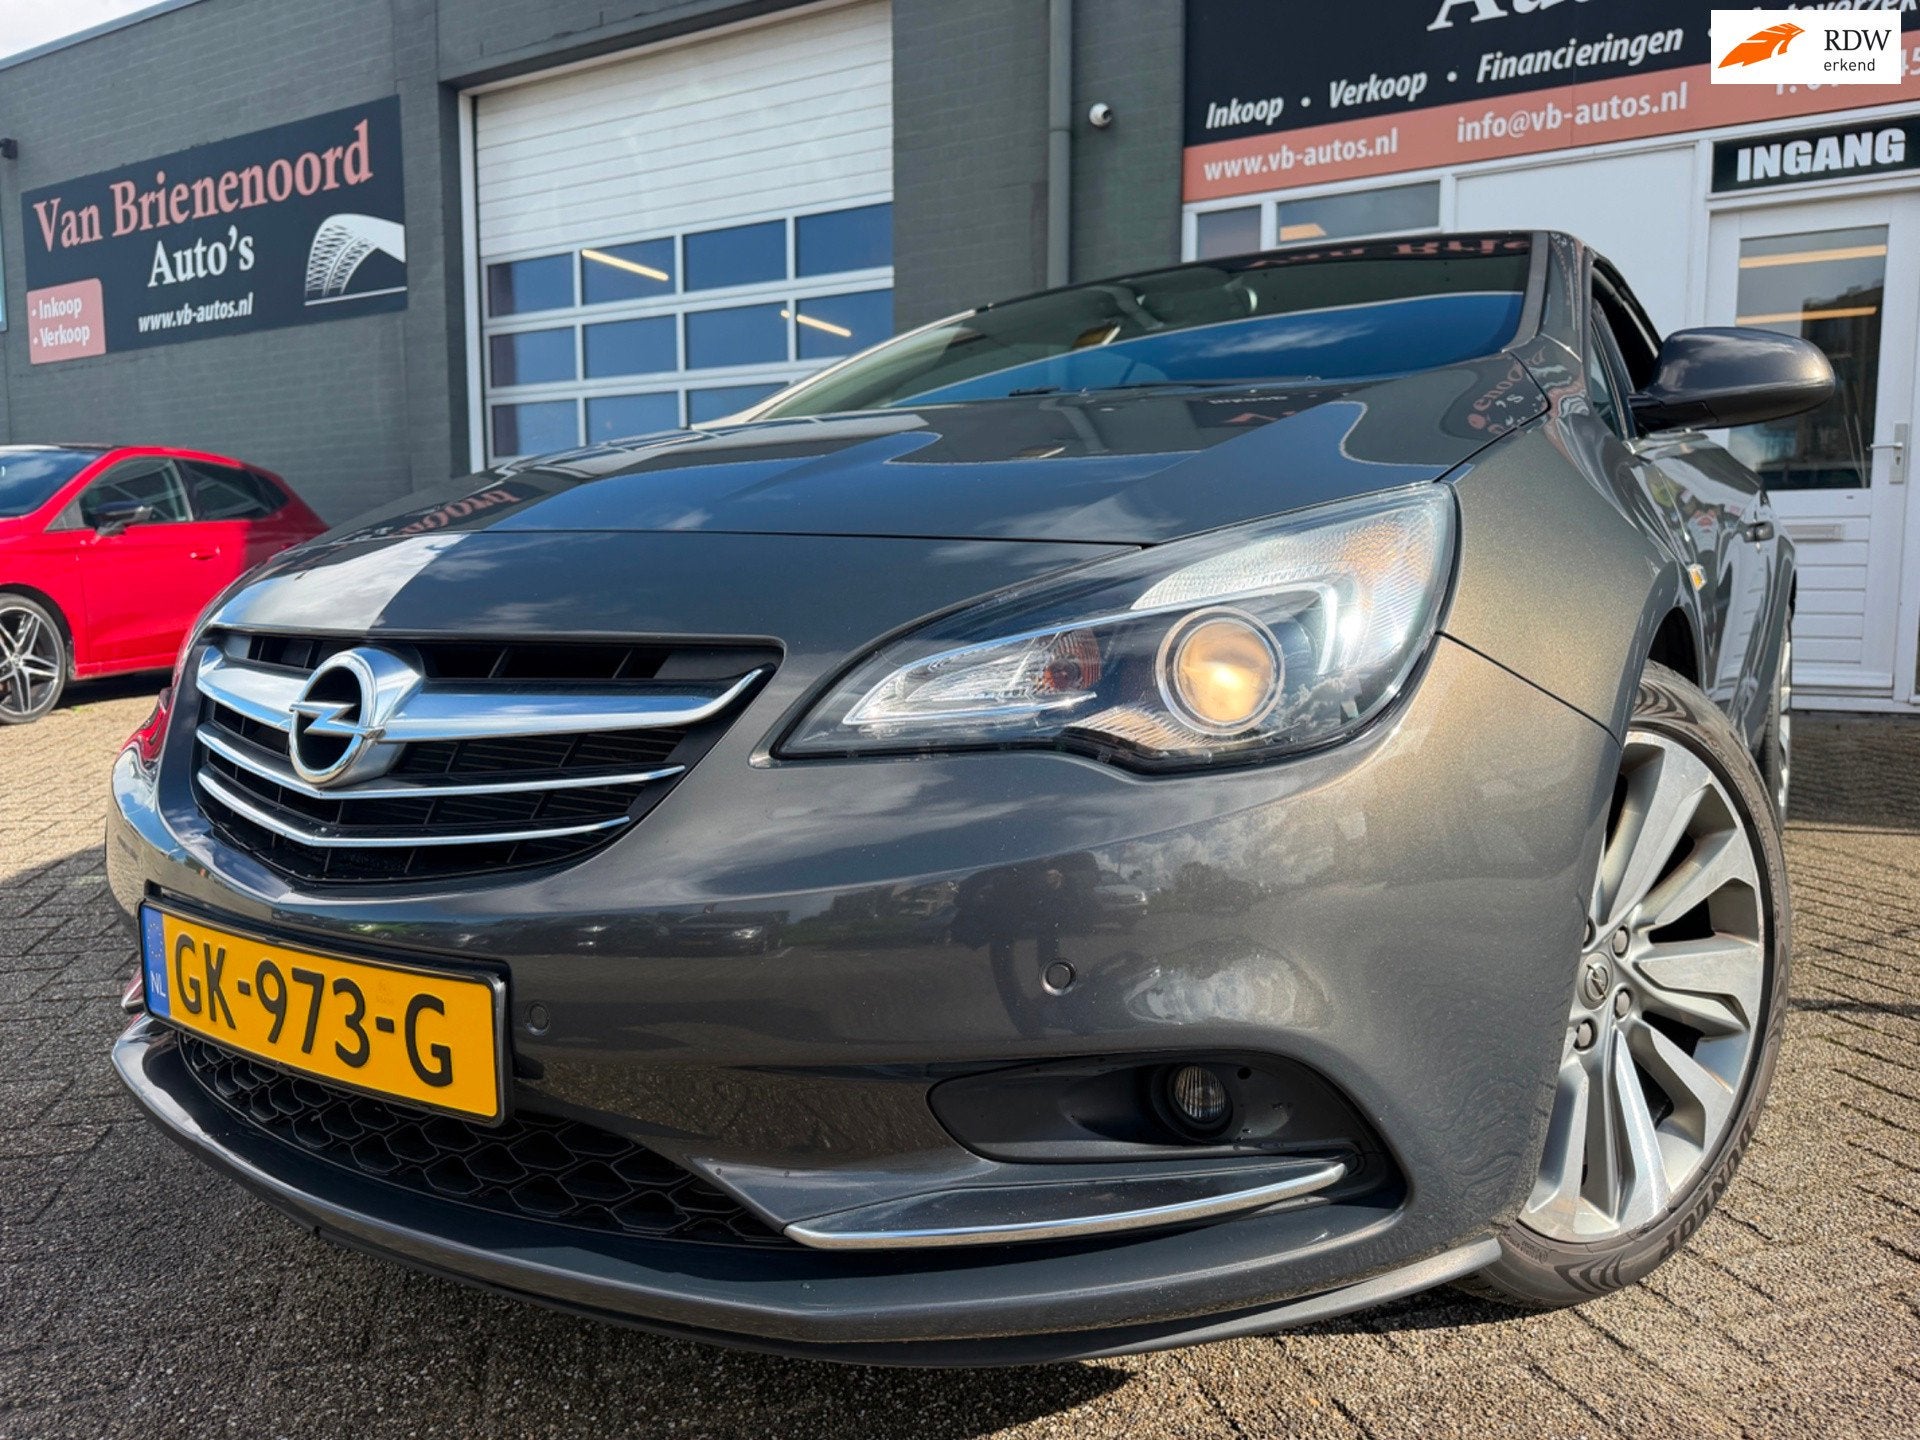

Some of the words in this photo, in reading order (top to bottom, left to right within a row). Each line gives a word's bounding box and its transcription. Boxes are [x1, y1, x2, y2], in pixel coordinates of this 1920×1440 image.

[1206, 97, 1284, 129] Inkoop
[1329, 71, 1428, 108] Verkoop
[1476, 27, 1684, 84] Financieringen
[1204, 127, 1399, 181] www.vb-autos.nl
[1457, 81, 1688, 143] info@vb-autos.nl
[1736, 128, 1906, 182] INGANG
[33, 197, 103, 252] Van
[109, 118, 374, 238] Brienenoord
[147, 224, 255, 288] Auto's
[38, 295, 83, 320] Inkoop
[40, 323, 91, 348] Verkoop
[138, 292, 253, 333] www.vb-autos.nl
[150, 972, 166, 998] NL
[174, 933, 454, 1087] GK-973-G
[1658, 1115, 1753, 1262] DUNLOP
